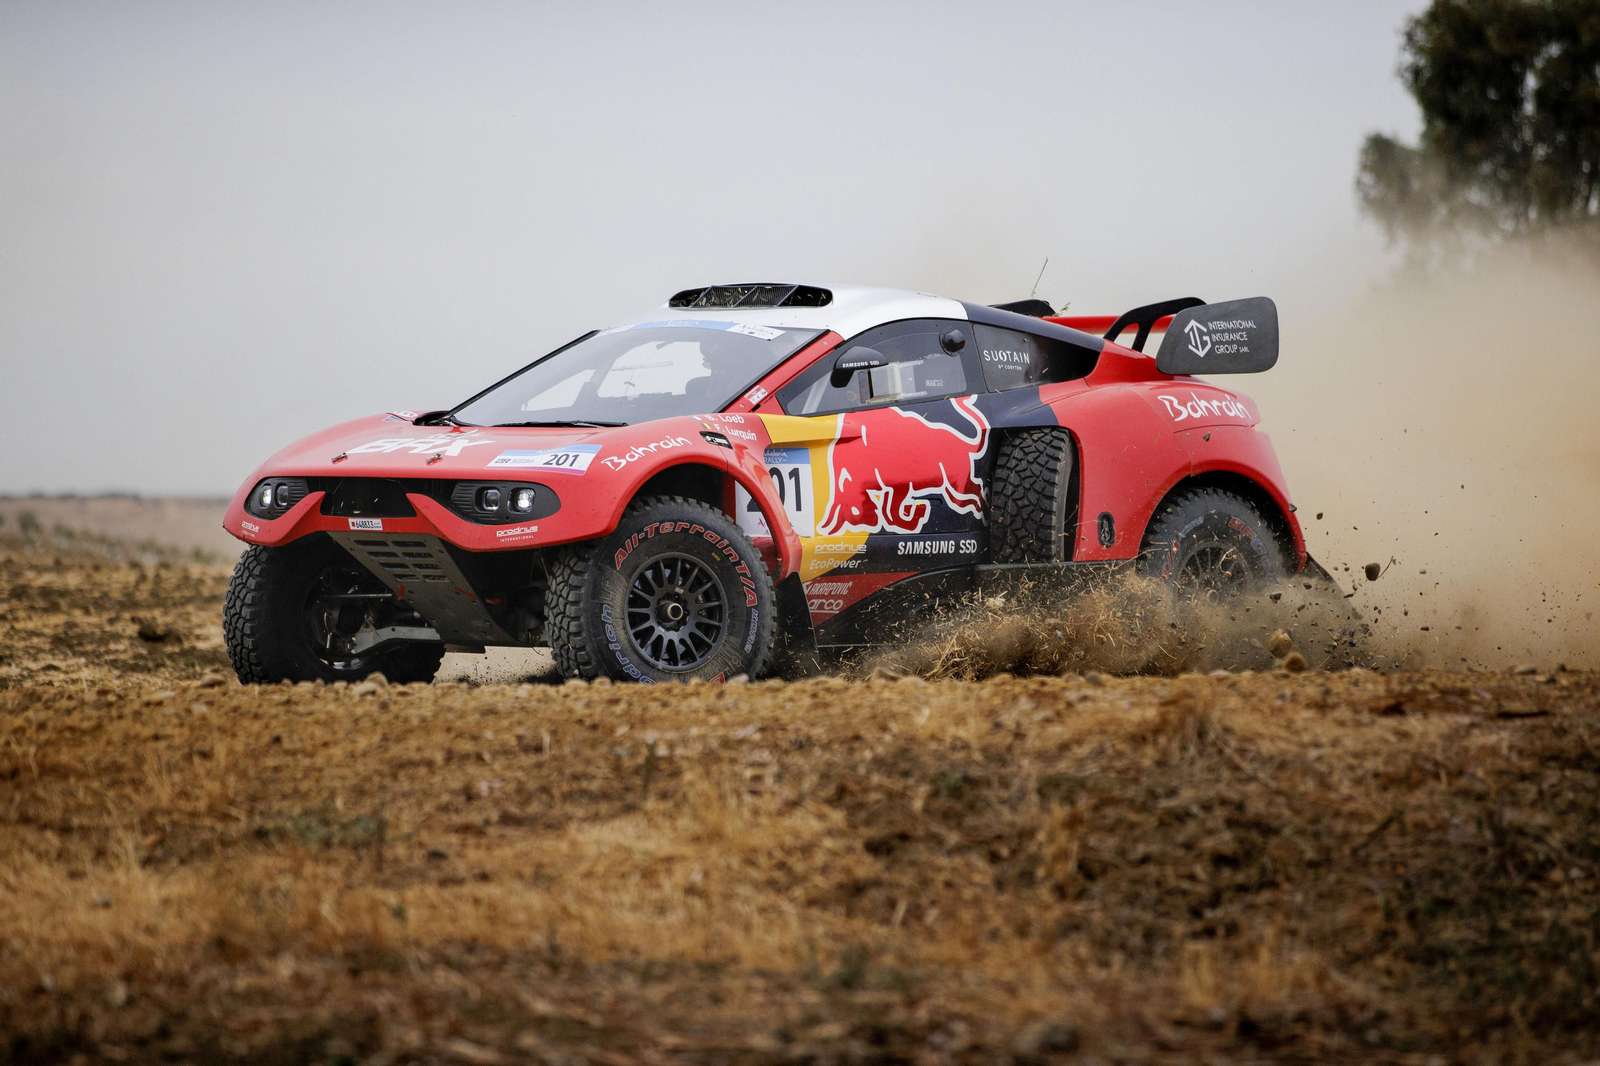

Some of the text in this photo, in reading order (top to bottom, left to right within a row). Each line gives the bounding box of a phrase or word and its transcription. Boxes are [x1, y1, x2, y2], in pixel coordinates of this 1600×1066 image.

[1208, 320, 1257, 330] INTERNATIONAL
[1211, 331, 1249, 342] INSURANCE
[1214, 344, 1238, 354] GROUP
[1158, 393, 1252, 422] Bahrain
[718, 414, 745, 424] Loeb
[713, 423, 758, 441] F. Lurquin
[345, 438, 496, 457] BRX
[600, 436, 693, 471] Bahrain
[542, 454, 580, 467] 201
[496, 525, 539, 538] prodrive
[814, 541, 867, 554] prodrive
[897, 539, 978, 555] SAMSUNG SSD
[809, 558, 862, 570] EcoPower
[808, 599, 844, 613] arco
